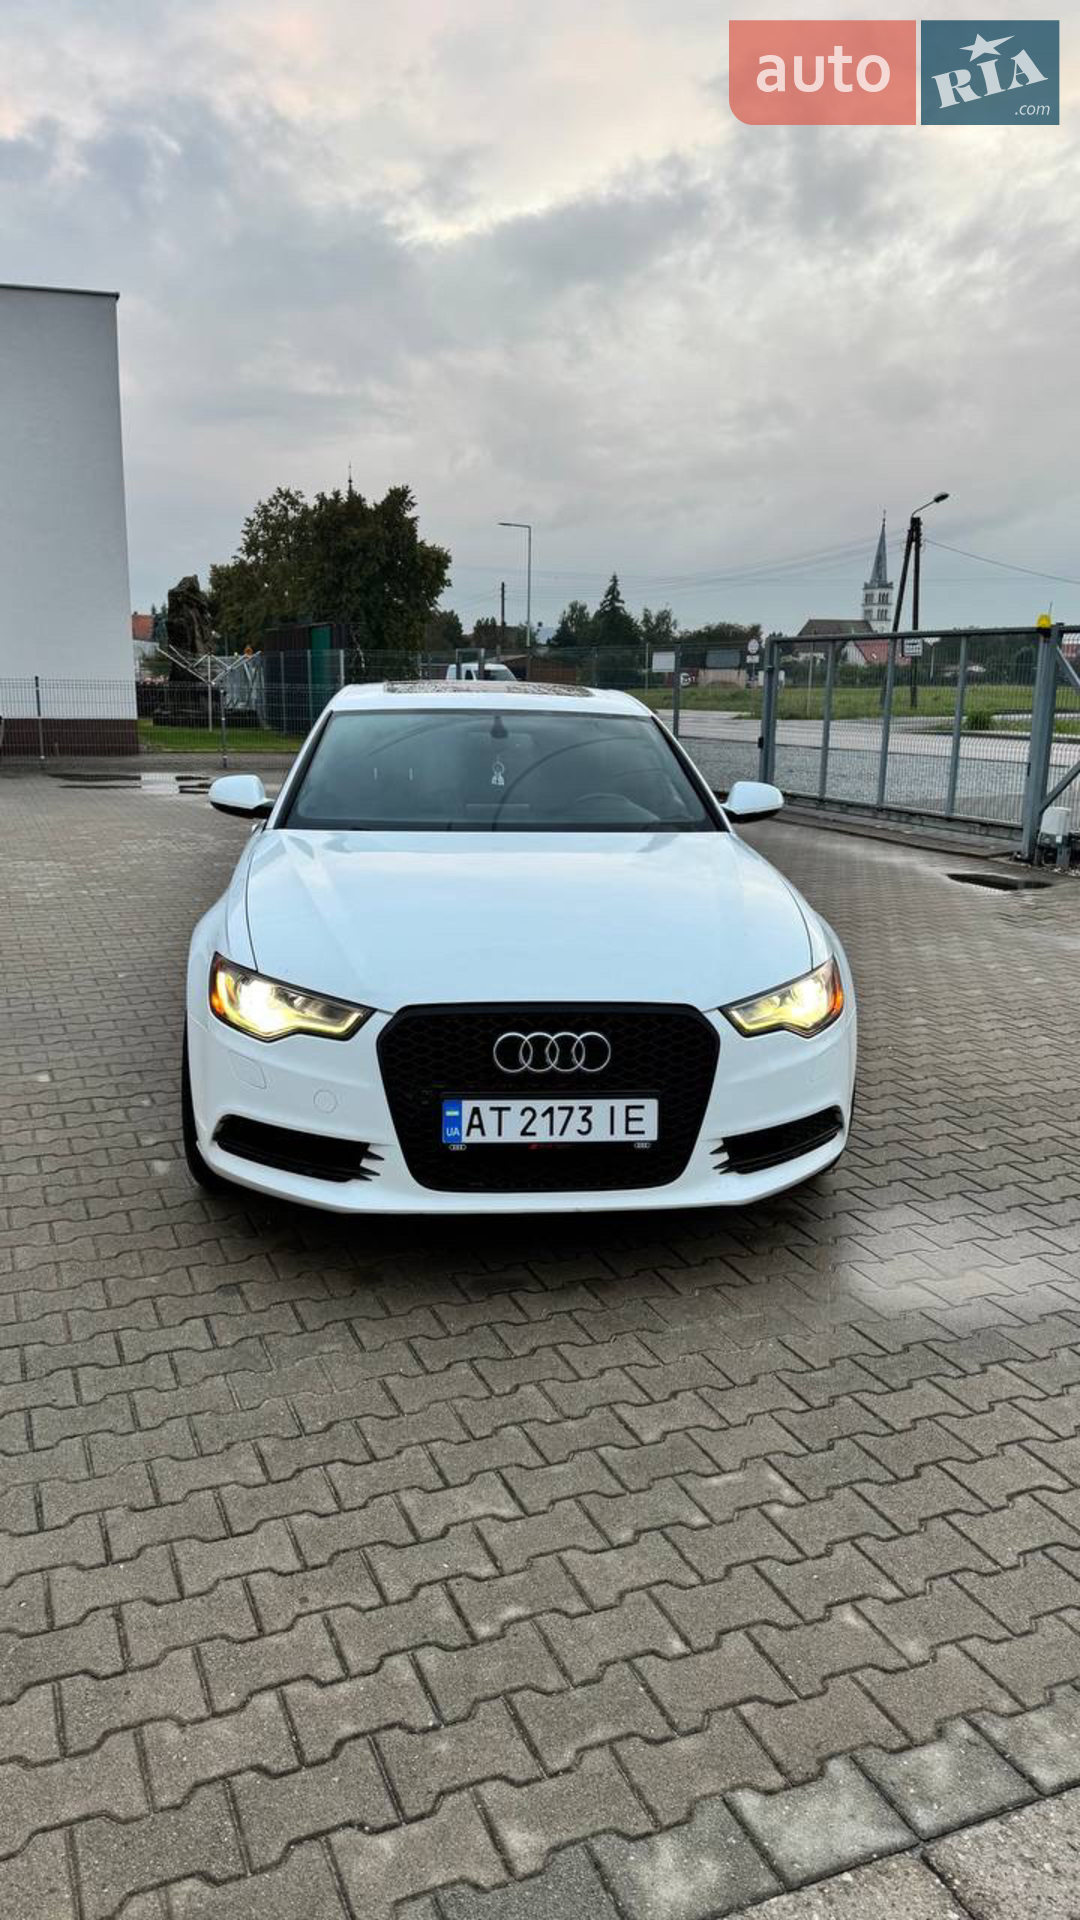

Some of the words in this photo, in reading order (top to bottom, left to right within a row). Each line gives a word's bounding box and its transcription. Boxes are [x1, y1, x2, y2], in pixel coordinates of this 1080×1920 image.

[465, 1106, 511, 1137] AT
[519, 1105, 593, 1136] 2173
[609, 1105, 646, 1135] IE
[446, 1127, 460, 1137] UA
